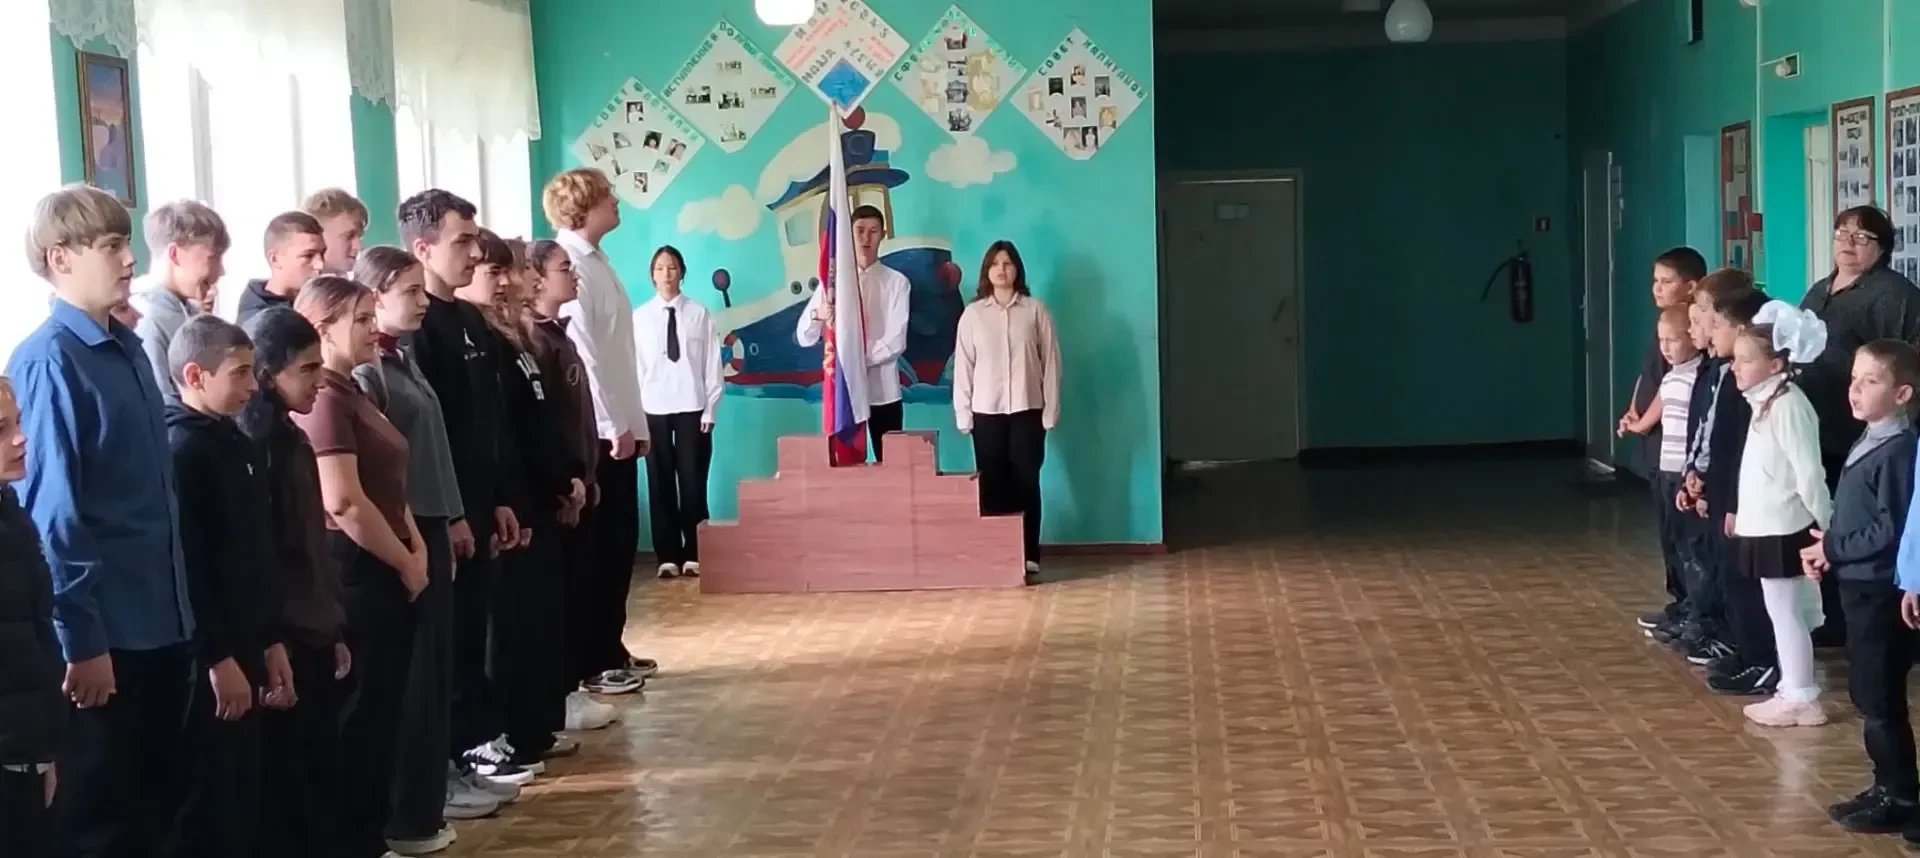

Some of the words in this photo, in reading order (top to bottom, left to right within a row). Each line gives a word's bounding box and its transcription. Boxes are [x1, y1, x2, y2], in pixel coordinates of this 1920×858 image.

[1036, 36, 1075, 77] СОВЕТ
[1083, 38, 1145, 100] КАПИТАНОВ
[593, 87, 629, 128] СОВЕТ
